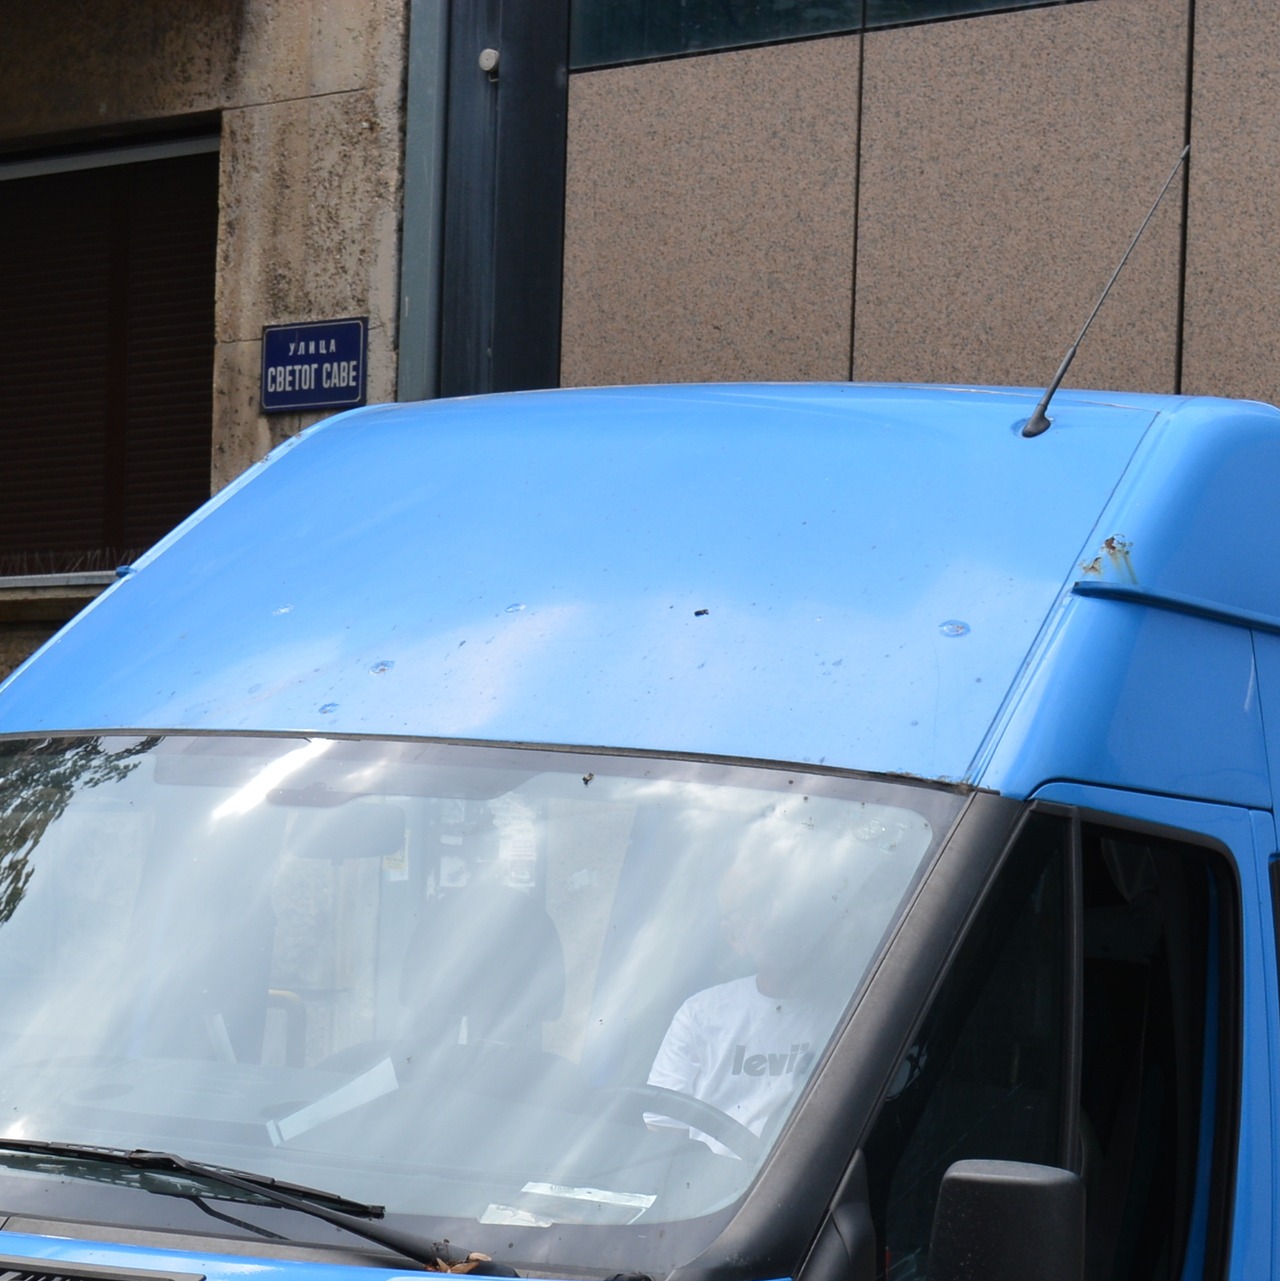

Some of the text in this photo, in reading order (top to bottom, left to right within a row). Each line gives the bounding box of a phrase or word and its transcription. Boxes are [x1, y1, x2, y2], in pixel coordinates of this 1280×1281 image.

[288, 338, 336, 356] УЛИЦА
[267, 360, 358, 393] СВЕТОГ САВЕ
